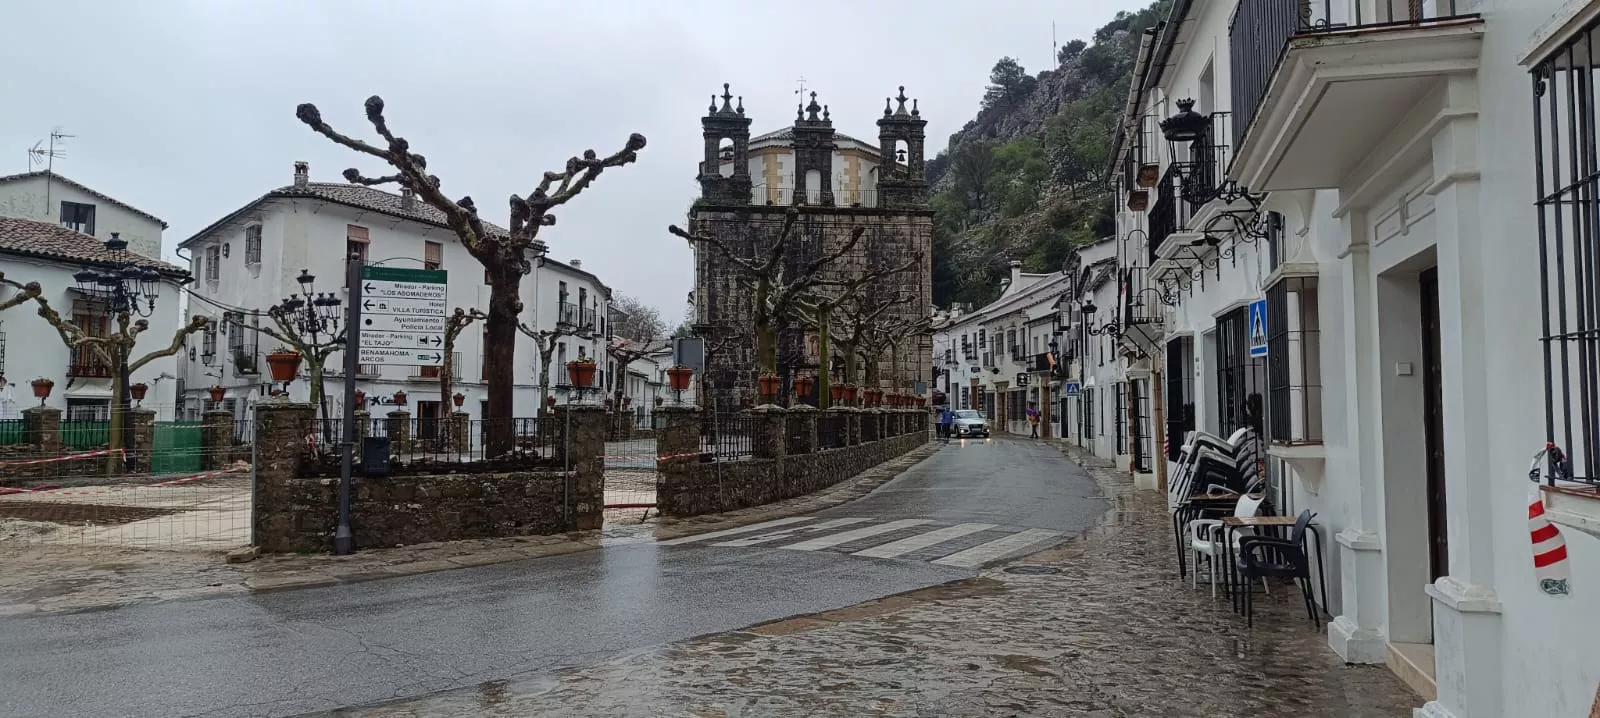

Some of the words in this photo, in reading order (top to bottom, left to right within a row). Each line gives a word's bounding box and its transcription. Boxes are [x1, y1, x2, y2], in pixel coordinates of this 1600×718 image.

[422, 284, 445, 292] Parking
[389, 333, 413, 341] Parking
[360, 349, 410, 357] BENAMAHOMA
